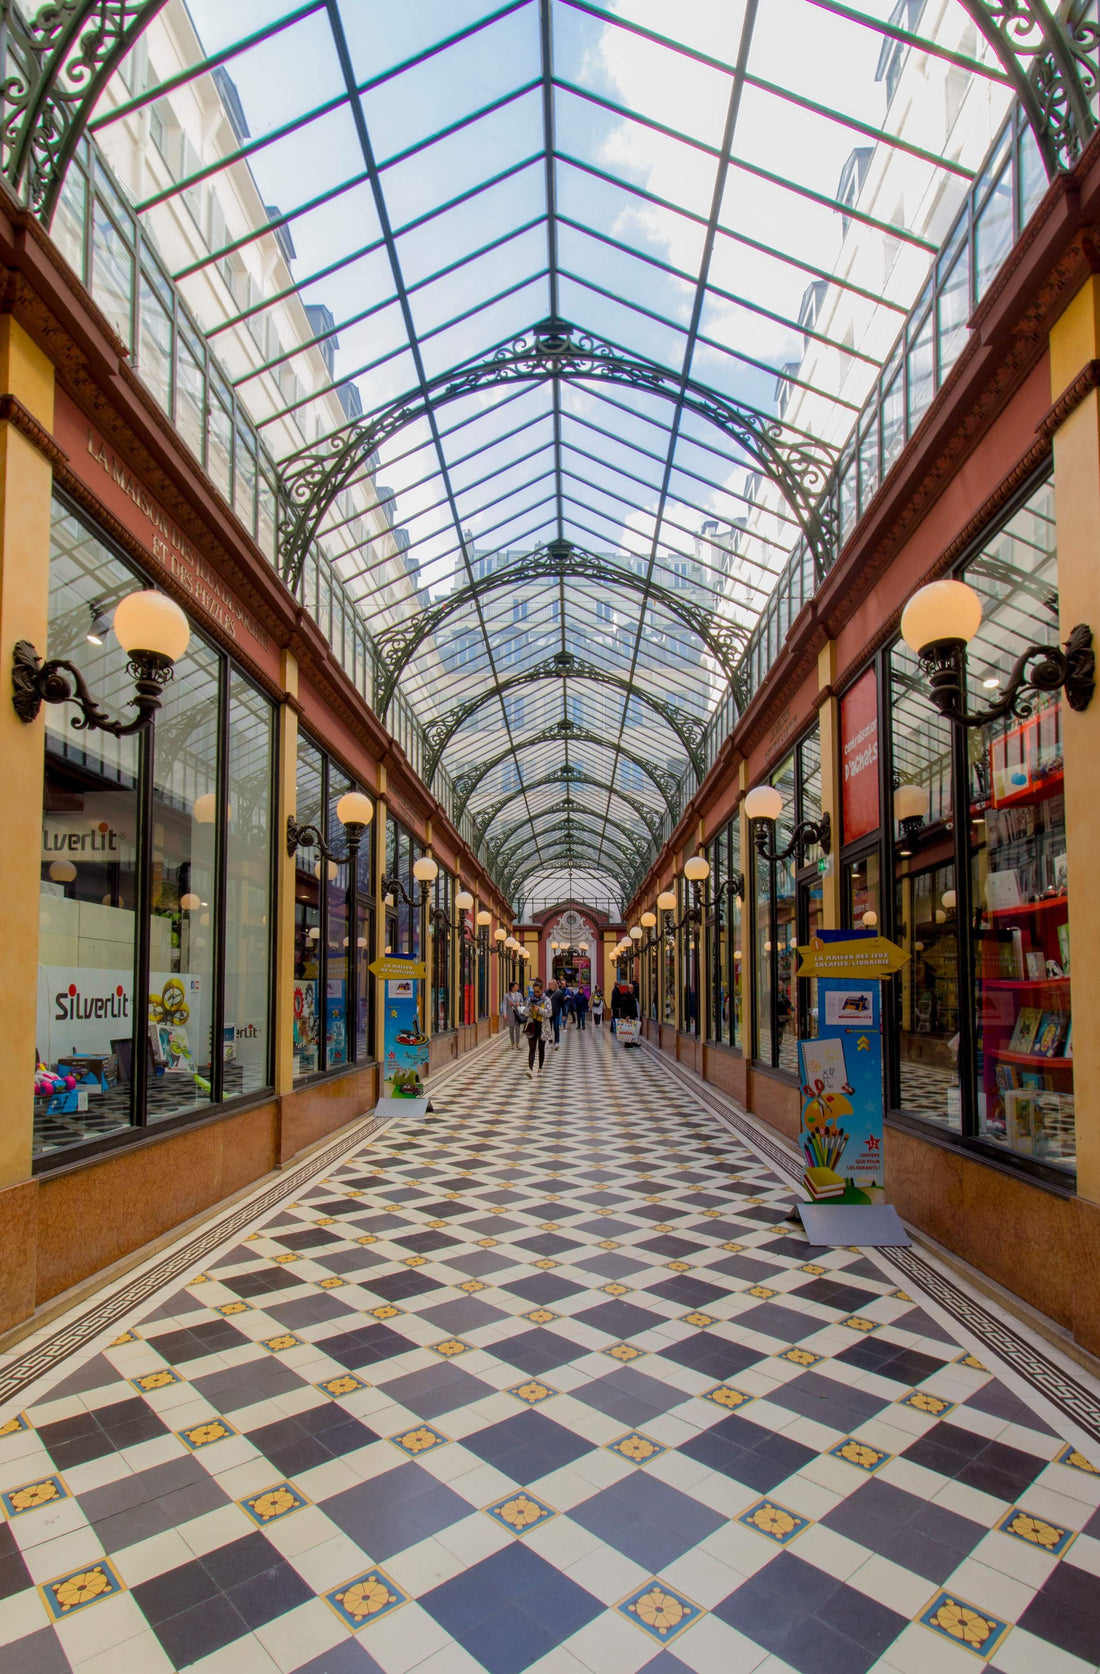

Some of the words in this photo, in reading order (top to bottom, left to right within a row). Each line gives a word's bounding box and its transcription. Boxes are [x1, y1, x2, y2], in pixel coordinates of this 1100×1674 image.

[111, 455, 169, 539] MAISON
[152, 533, 169, 567] ET
[43, 822, 118, 852] lverlit
[55, 983, 129, 1021] Silverlit
